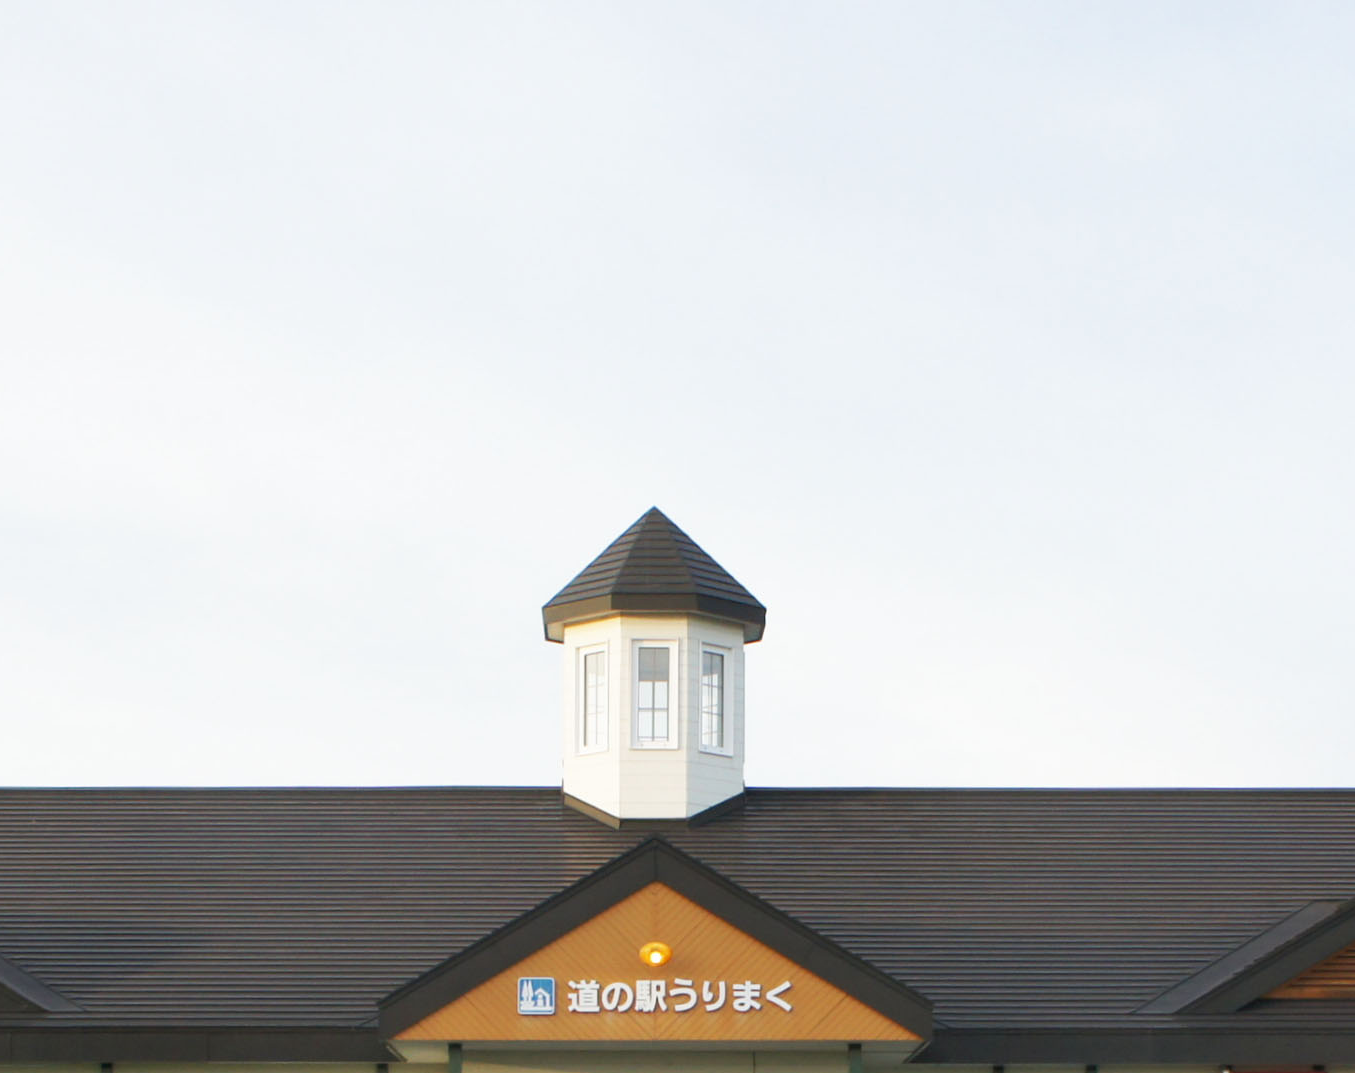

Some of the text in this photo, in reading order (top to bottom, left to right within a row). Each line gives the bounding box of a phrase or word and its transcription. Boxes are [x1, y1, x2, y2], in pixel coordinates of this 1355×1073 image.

[567, 978, 793, 1013] 道の駅うりまく
